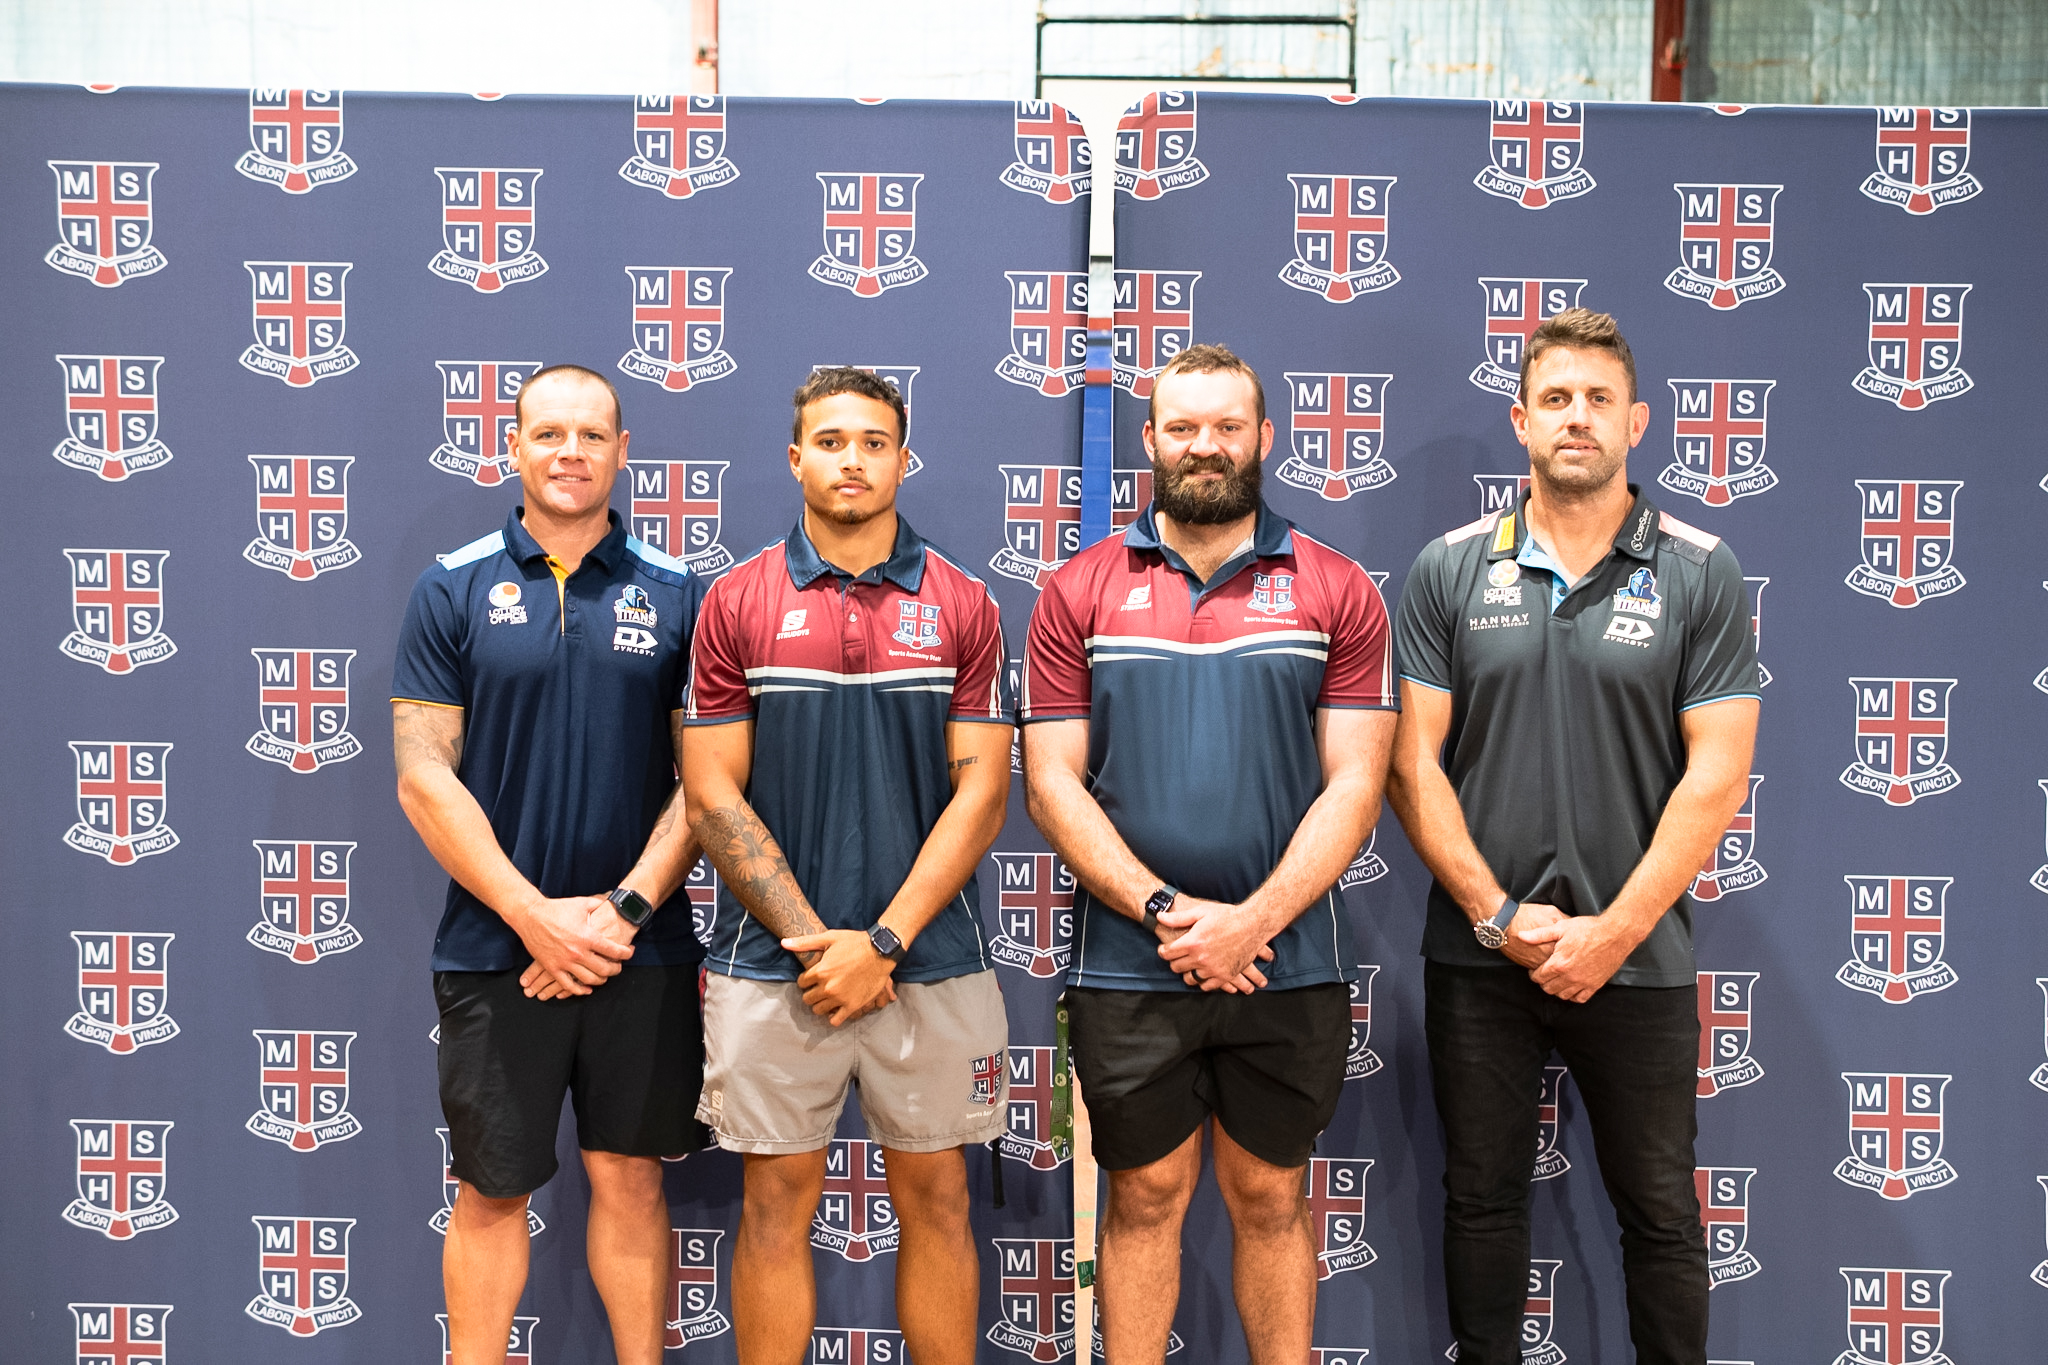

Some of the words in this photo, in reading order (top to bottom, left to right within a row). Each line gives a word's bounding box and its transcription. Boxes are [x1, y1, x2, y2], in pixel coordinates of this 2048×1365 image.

[1164, 135, 1183, 159] S
[64, 171, 90, 195] M
[119, 172, 139, 197] S
[1162, 167, 1200, 187] VINCIT
[450, 178, 474, 201] M
[504, 178, 523, 202] S
[831, 183, 855, 206] M
[885, 183, 904, 207] S
[1302, 185, 1327, 209] M
[1357, 186, 1376, 210] S
[71, 222, 92, 246] H
[121, 223, 141, 247] S
[455, 229, 474, 252] H
[504, 229, 523, 253] S
[836, 233, 855, 257] H
[884, 234, 903, 258] S
[1307, 237, 1326, 261] H
[1356, 238, 1375, 262] S
[53, 253, 94, 274] LABOR
[121, 255, 157, 275] VINCIT
[436, 259, 475, 281] LABOR
[503, 261, 539, 280] VINCIT
[816, 264, 855, 285] LABOR
[882, 265, 919, 285] VINCIT
[640, 277, 664, 300] M
[694, 277, 712, 301] S
[1286, 268, 1326, 290] LABOR
[1354, 271, 1391, 290] VINCIT
[1019, 281, 1043, 305] M
[1072, 283, 1087, 306] S
[1877, 294, 1902, 317] M
[1932, 294, 1951, 318] S
[645, 328, 664, 351] H
[693, 328, 712, 352] S
[1023, 333, 1042, 356] H
[1071, 334, 1086, 357] S
[1880, 345, 1900, 369] H
[1929, 345, 1948, 369] S
[625, 358, 664, 380] LABOR
[691, 360, 728, 379] VINCIT
[1003, 363, 1041, 385] LABOR
[451, 371, 474, 394] M
[504, 371, 523, 395] S
[1860, 376, 1899, 398] LABOR
[1927, 378, 1964, 397] VINCIT
[1682, 389, 1706, 413] M
[1736, 390, 1755, 414] S
[456, 422, 475, 445] H
[437, 453, 475, 474] LABOR
[1686, 441, 1705, 465] H
[1734, 442, 1753, 466] S
[263, 465, 287, 489] M
[317, 466, 335, 490] S
[638, 470, 662, 493] M
[691, 471, 709, 494] S
[1013, 475, 1037, 498] M
[1066, 477, 1081, 500] S
[1665, 472, 1704, 494] LABOR
[1732, 474, 1769, 493] VINCIT
[269, 516, 288, 540] H
[317, 517, 336, 541] S
[691, 522, 709, 545] S
[1016, 526, 1035, 550] H
[1064, 528, 1079, 551] S
[251, 547, 290, 568] LABOR
[316, 548, 352, 568] VINCIT
[689, 553, 725, 573] VINCIT
[997, 557, 1035, 578] LABOR
[78, 559, 103, 583] M
[132, 560, 150, 584] S
[1256, 577, 1268, 586] M
[1277, 578, 1287, 587] S
[1257, 592, 1267, 602] H
[1277, 593, 1286, 603] S
[1483, 586, 1522, 597] LOTTERY
[1483, 593, 1521, 604] OFFICE
[489, 606, 525, 617] LOTTERY
[490, 612, 528, 624] OFFICE
[616, 607, 657, 627] TITANS
[903, 604, 914, 614] M
[924, 607, 934, 617] S
[1615, 597, 1661, 618] TITANS
[85, 610, 105, 634] H
[133, 610, 152, 635] S
[904, 623, 914, 633] H
[923, 626, 933, 635] S
[1469, 613, 1529, 627] HANNAY
[776, 629, 809, 640] STRUDDYS
[1602, 634, 1650, 648] DYNASTY
[67, 641, 106, 662] LABOR
[132, 642, 168, 661] VINCIT
[614, 645, 655, 657] DYNASTY
[889, 649, 906, 658] Sports
[906, 650, 929, 661] Academy
[929, 654, 942, 662] Staff
[1863, 688, 1888, 712] M
[1918, 689, 1936, 713] S
[1868, 740, 1887, 764] H
[1916, 741, 1935, 765] S
[1847, 771, 1887, 793] LABOR
[1914, 773, 1951, 793] VINCIT
[1724, 837, 1742, 861] S
[268, 850, 291, 873] M
[320, 851, 338, 875] S
[1006, 863, 1029, 885] M
[1059, 865, 1073, 886] S
[1722, 869, 1758, 888] VINCIT
[273, 901, 291, 923] H
[320, 901, 338, 925] S
[1011, 914, 1029, 936] H
[1059, 915, 1072, 937] S
[254, 931, 292, 951] LABOR
[318, 933, 353, 951] VINCIT
[85, 942, 109, 965] M
[137, 942, 155, 966] S
[992, 944, 1030, 965] LABOR
[90, 992, 109, 1014] H
[137, 992, 155, 1016] S
[72, 1021, 110, 1042] LABOR
[136, 1023, 171, 1042] VINCIT
[975, 1060, 986, 1072] M
[996, 1055, 1002, 1066] S
[978, 1081, 987, 1092] H
[1857, 1083, 1881, 1107] M
[1912, 1084, 1931, 1108] S
[1862, 1135, 1881, 1158] H
[1911, 1136, 1931, 1160] S
[1841, 1165, 1881, 1187] LABOR
[1910, 1168, 1947, 1187] VINCIT
[687, 1239, 705, 1261] S
[1008, 1249, 1030, 1271] M
[1061, 1249, 1074, 1271] S
[687, 1288, 705, 1310] S
[1013, 1300, 1031, 1322] H
[1061, 1300, 1074, 1323] S
[686, 1319, 721, 1337] VINCIT
[994, 1330, 1032, 1350] LABOR
